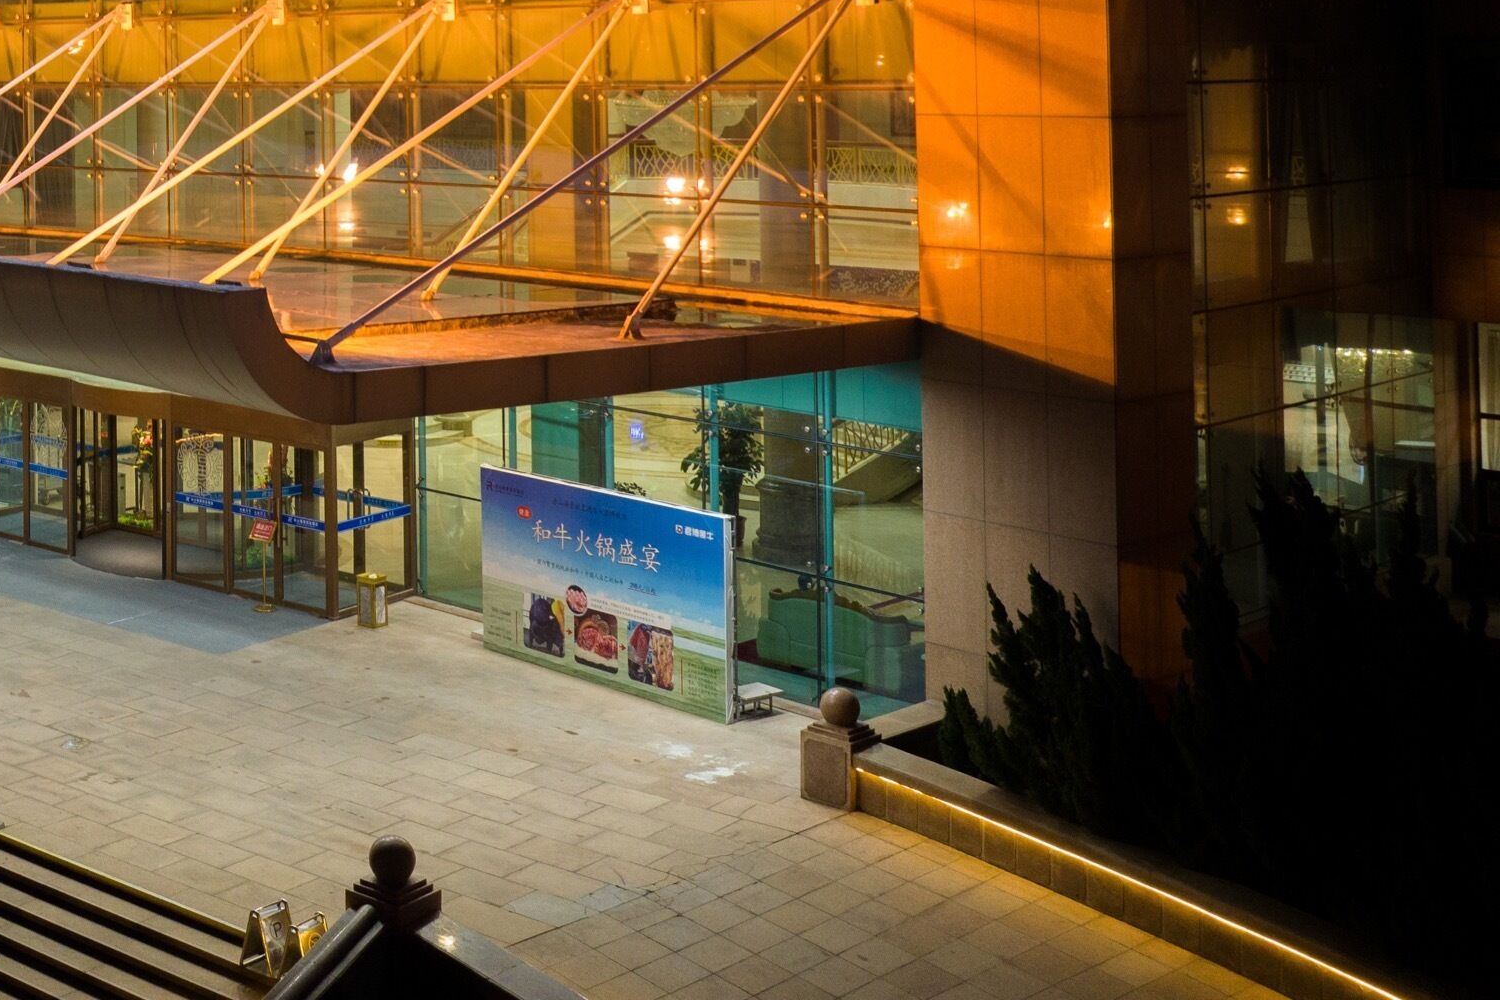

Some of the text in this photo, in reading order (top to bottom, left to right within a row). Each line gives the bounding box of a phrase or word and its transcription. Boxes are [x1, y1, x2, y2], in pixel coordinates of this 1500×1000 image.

[532, 519, 661, 573] 和牛火锅盛宴
[273, 921, 282, 938] P
